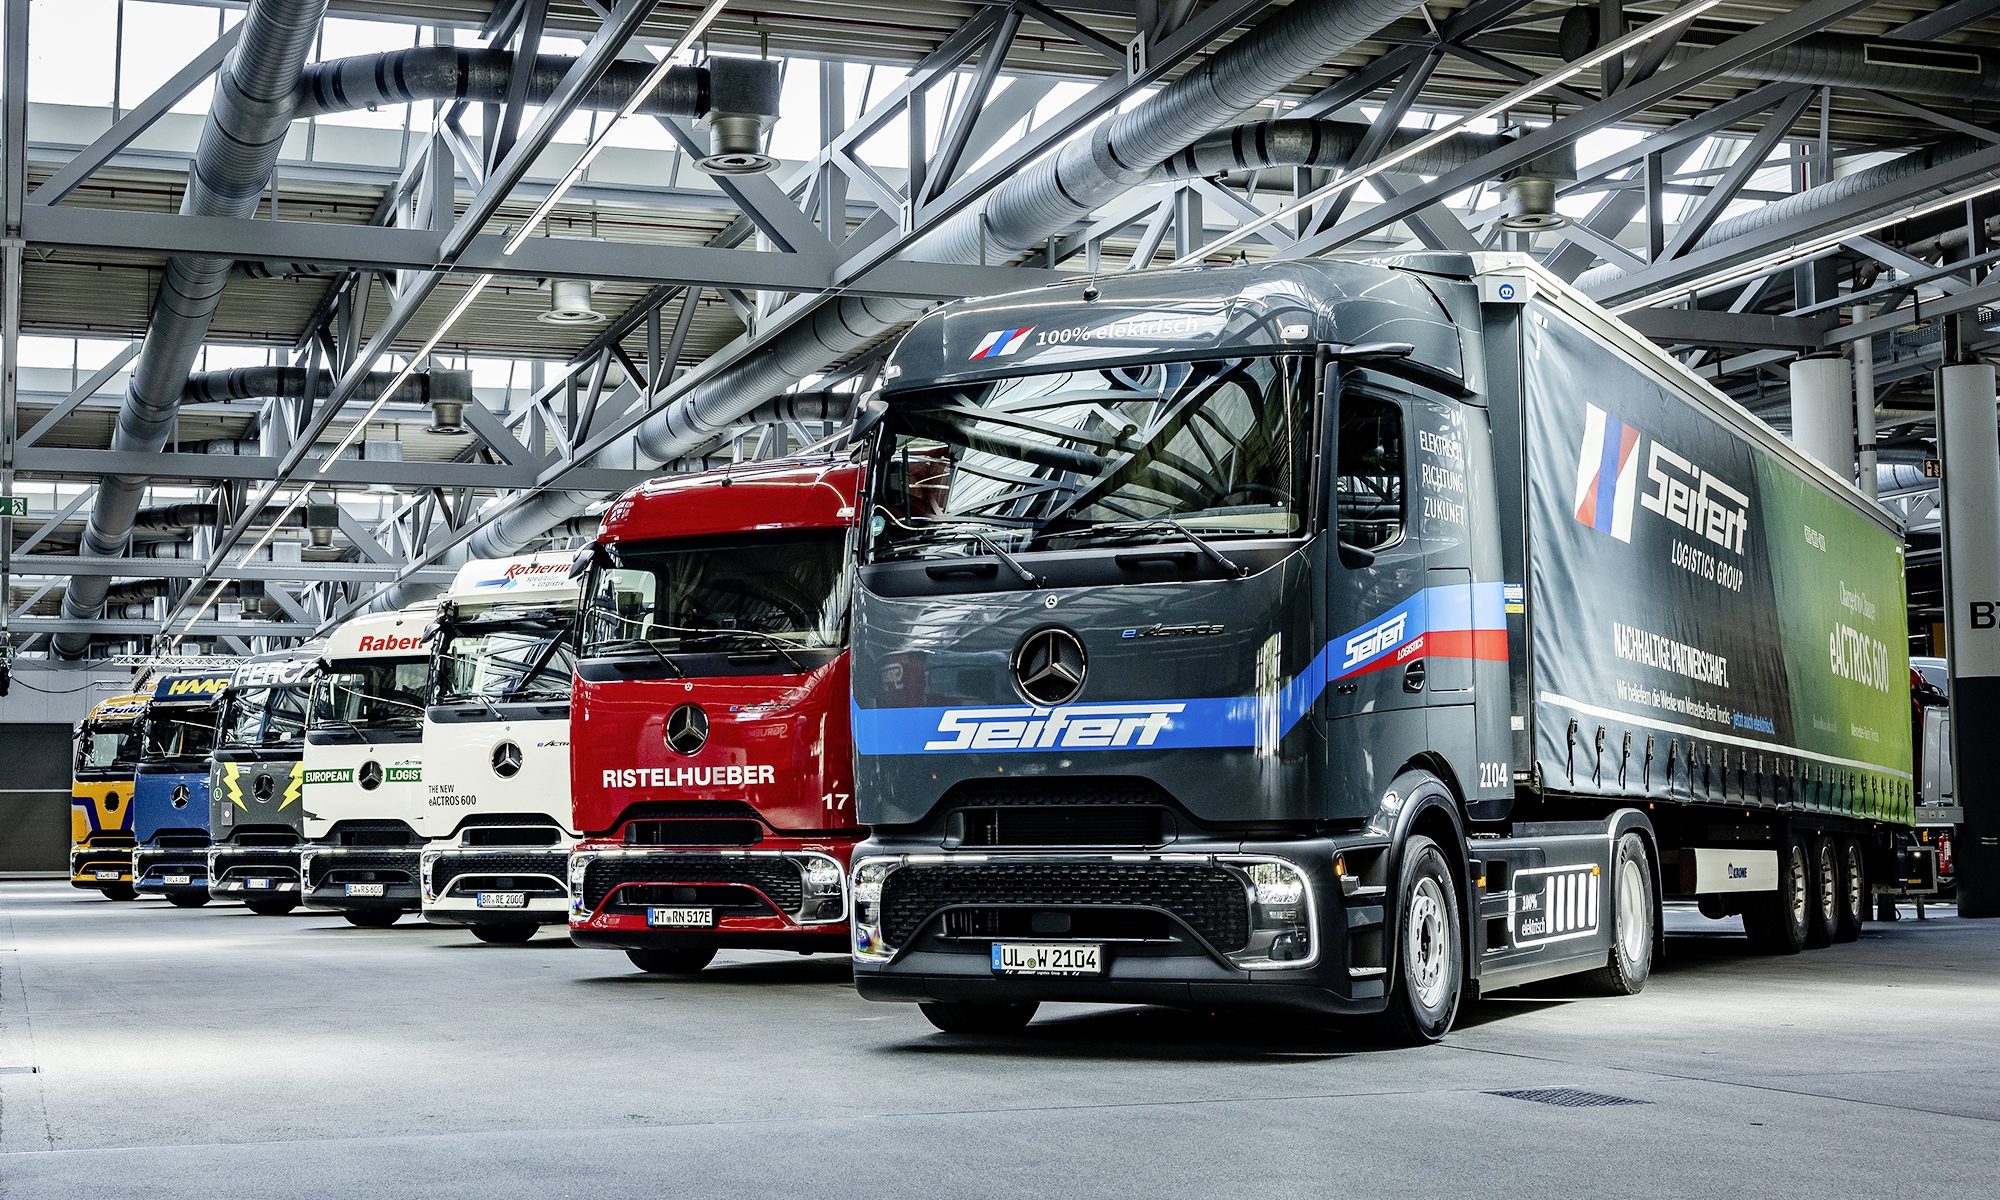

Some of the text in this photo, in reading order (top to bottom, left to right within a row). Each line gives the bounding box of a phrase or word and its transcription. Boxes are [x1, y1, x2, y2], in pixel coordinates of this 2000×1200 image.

[1133, 42, 1139, 74] 6
[1035, 316, 1199, 346] 100% elektrisch
[1422, 463, 1464, 493] RICHTUNG
[1641, 440, 1749, 555] Seifert
[503, 563, 573, 579] Rotherm
[1671, 538, 1743, 592] LOGISTICS GROUP
[1970, 601, 2000, 629] B
[358, 635, 424, 652] Raben
[1343, 611, 1408, 670] Seifert
[1397, 636, 1424, 661] LOGISTICS
[1614, 622, 1729, 688] NACHHALTIGE PARTNERSCHAFT.
[1830, 622, 1889, 693] eACTROS 600
[1616, 679, 1628, 699] Wir
[1628, 682, 1651, 706] beliefern
[1652, 687, 1660, 708] die
[1677, 697, 1685, 712] von
[924, 703, 1187, 751] Seifert
[306, 769, 422, 782] EUROPEAN LOGIST
[602, 765, 775, 788] RISTELHUEBER
[1480, 762, 1508, 788] 2104
[429, 785, 455, 793] THE NEW
[429, 795, 476, 806] eACTROS 600
[821, 793, 849, 810] 17
[361, 885, 369, 893] RS
[495, 895, 504, 904] RE
[654, 910, 711, 923] WT RN 517E
[1522, 917, 1545, 936] elektrisch
[1003, 949, 1024, 967] UL
[1037, 949, 1047, 967] W
[1053, 950, 1096, 968] 2104
